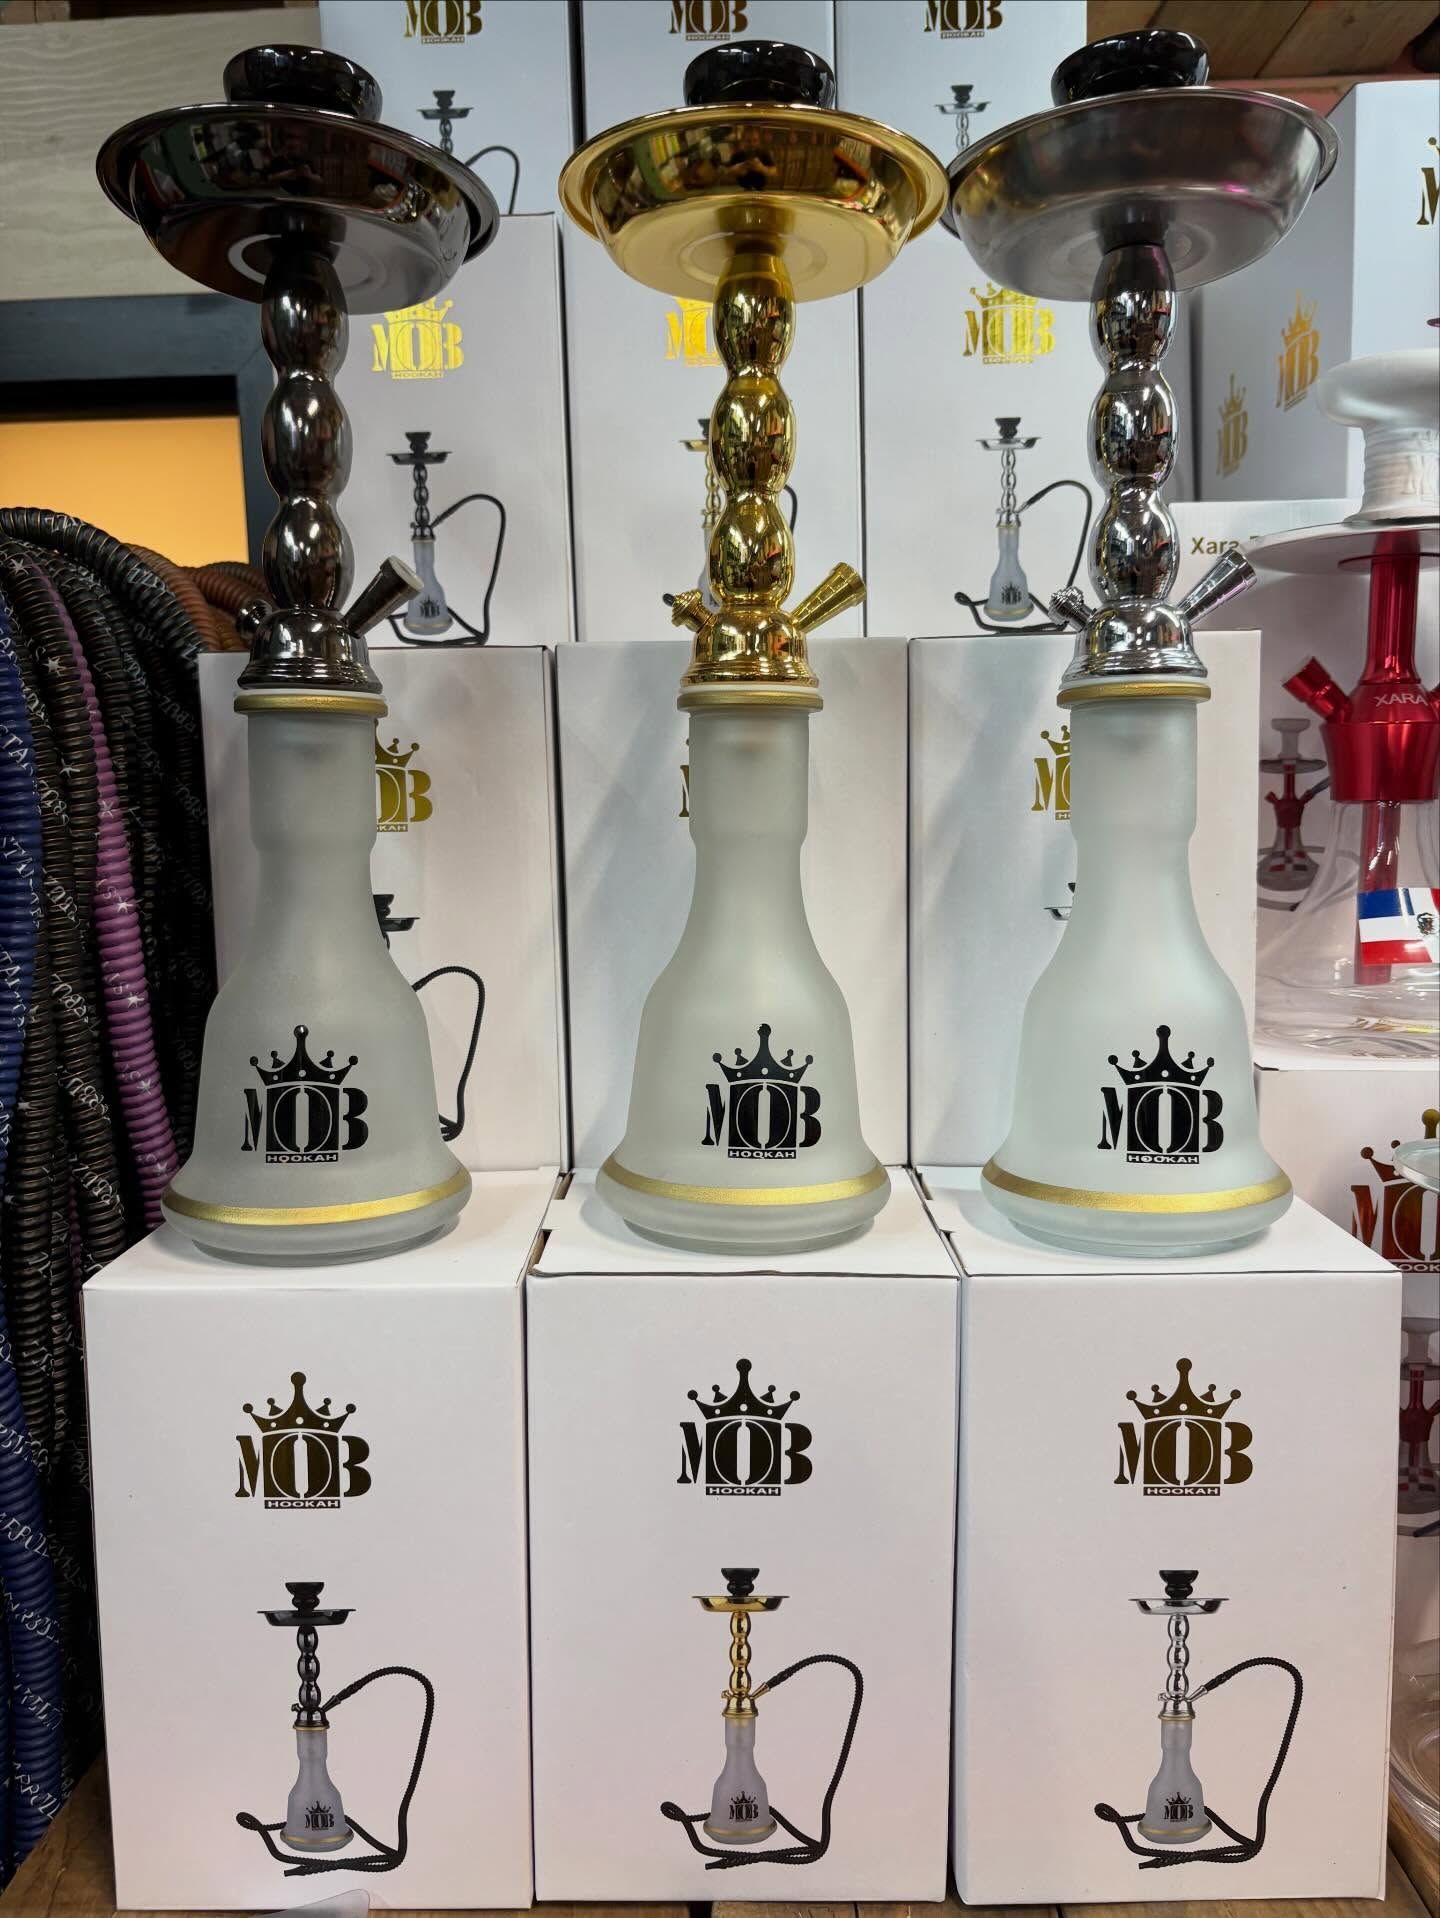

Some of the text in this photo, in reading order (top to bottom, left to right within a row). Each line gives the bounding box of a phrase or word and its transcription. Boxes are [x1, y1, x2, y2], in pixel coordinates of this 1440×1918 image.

[404, 0, 482, 37] MOB
[668, 0, 748, 34] MOB
[923, 0, 1003, 32] MOB
[371, 322, 464, 371] MOB
[963, 307, 1056, 356] MOB
[1374, 693, 1428, 707] XARA
[241, 1086, 368, 1152] MOB
[701, 1083, 821, 1149] MOB
[1098, 1086, 1224, 1153] MOB
[266, 1154, 338, 1163] HOOKAH
[728, 1149, 796, 1159] HOOKAH
[1127, 1154, 1199, 1164] HOOKAH
[235, 1433, 372, 1498] MOB
[677, 1420, 813, 1485] MOB
[1114, 1419, 1254, 1485] MOB
[265, 1500, 340, 1508] HOOKAH
[706, 1487, 781, 1495] HOOKAH
[1144, 1487, 1220, 1495] HOOKAH
